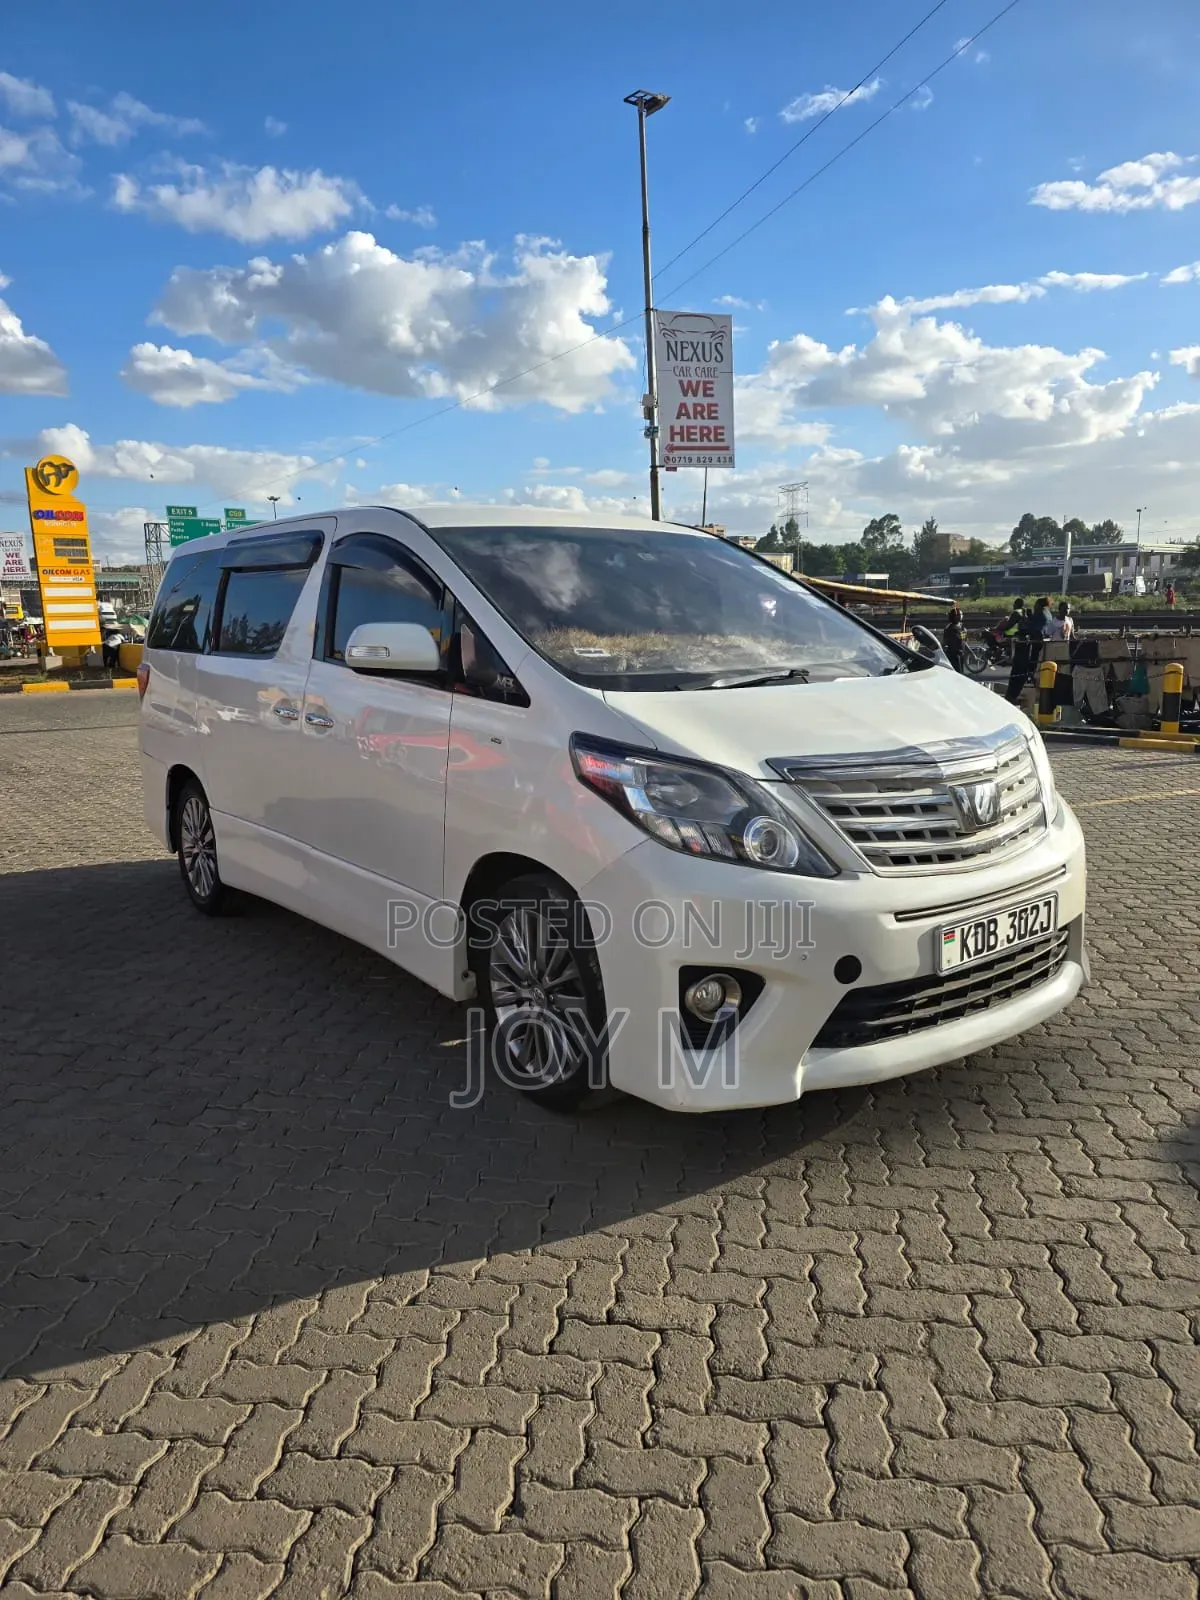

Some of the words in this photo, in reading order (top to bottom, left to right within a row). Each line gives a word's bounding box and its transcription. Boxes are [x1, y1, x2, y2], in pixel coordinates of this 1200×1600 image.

[666, 340, 724, 363] NEXUS
[673, 366, 691, 378] CAR
[695, 366, 719, 379] CARE
[678, 380, 715, 398] WE
[675, 402, 719, 420] ARE
[669, 425, 725, 443] HERE
[671, 455, 693, 464] 0719
[696, 455, 713, 464] 829
[33, 509, 84, 521] OILCOM
[959, 918, 999, 962] KDB
[1006, 900, 1052, 944] 302J
